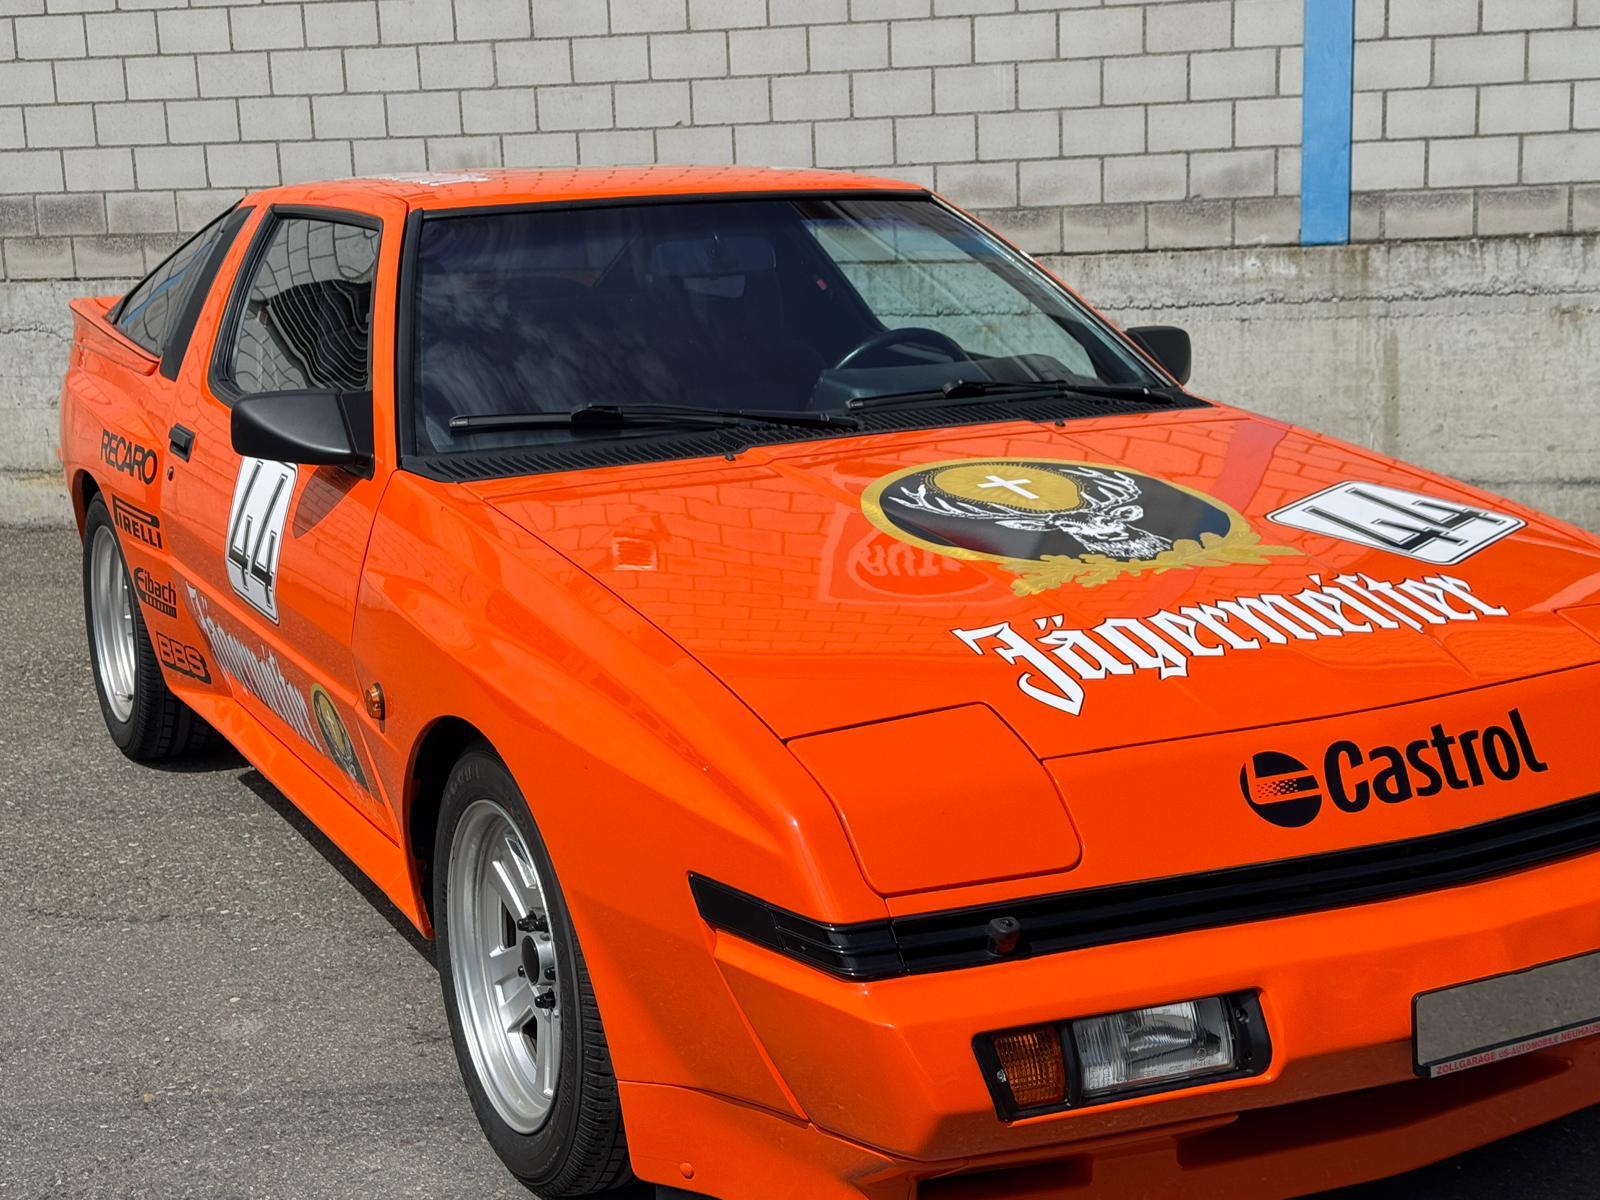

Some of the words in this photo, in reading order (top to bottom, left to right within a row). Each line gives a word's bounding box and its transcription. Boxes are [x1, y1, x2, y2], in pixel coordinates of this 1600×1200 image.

[101, 429, 158, 485] RECARO
[112, 494, 162, 549] PIRELLI
[228, 460, 287, 610] 44
[1302, 487, 1506, 554] 44
[133, 567, 177, 607] Eibach
[156, 632, 211, 684] BBS
[1324, 707, 1548, 813] Castrol
[1435, 1052, 1497, 1076] ZOLLGARAGE
